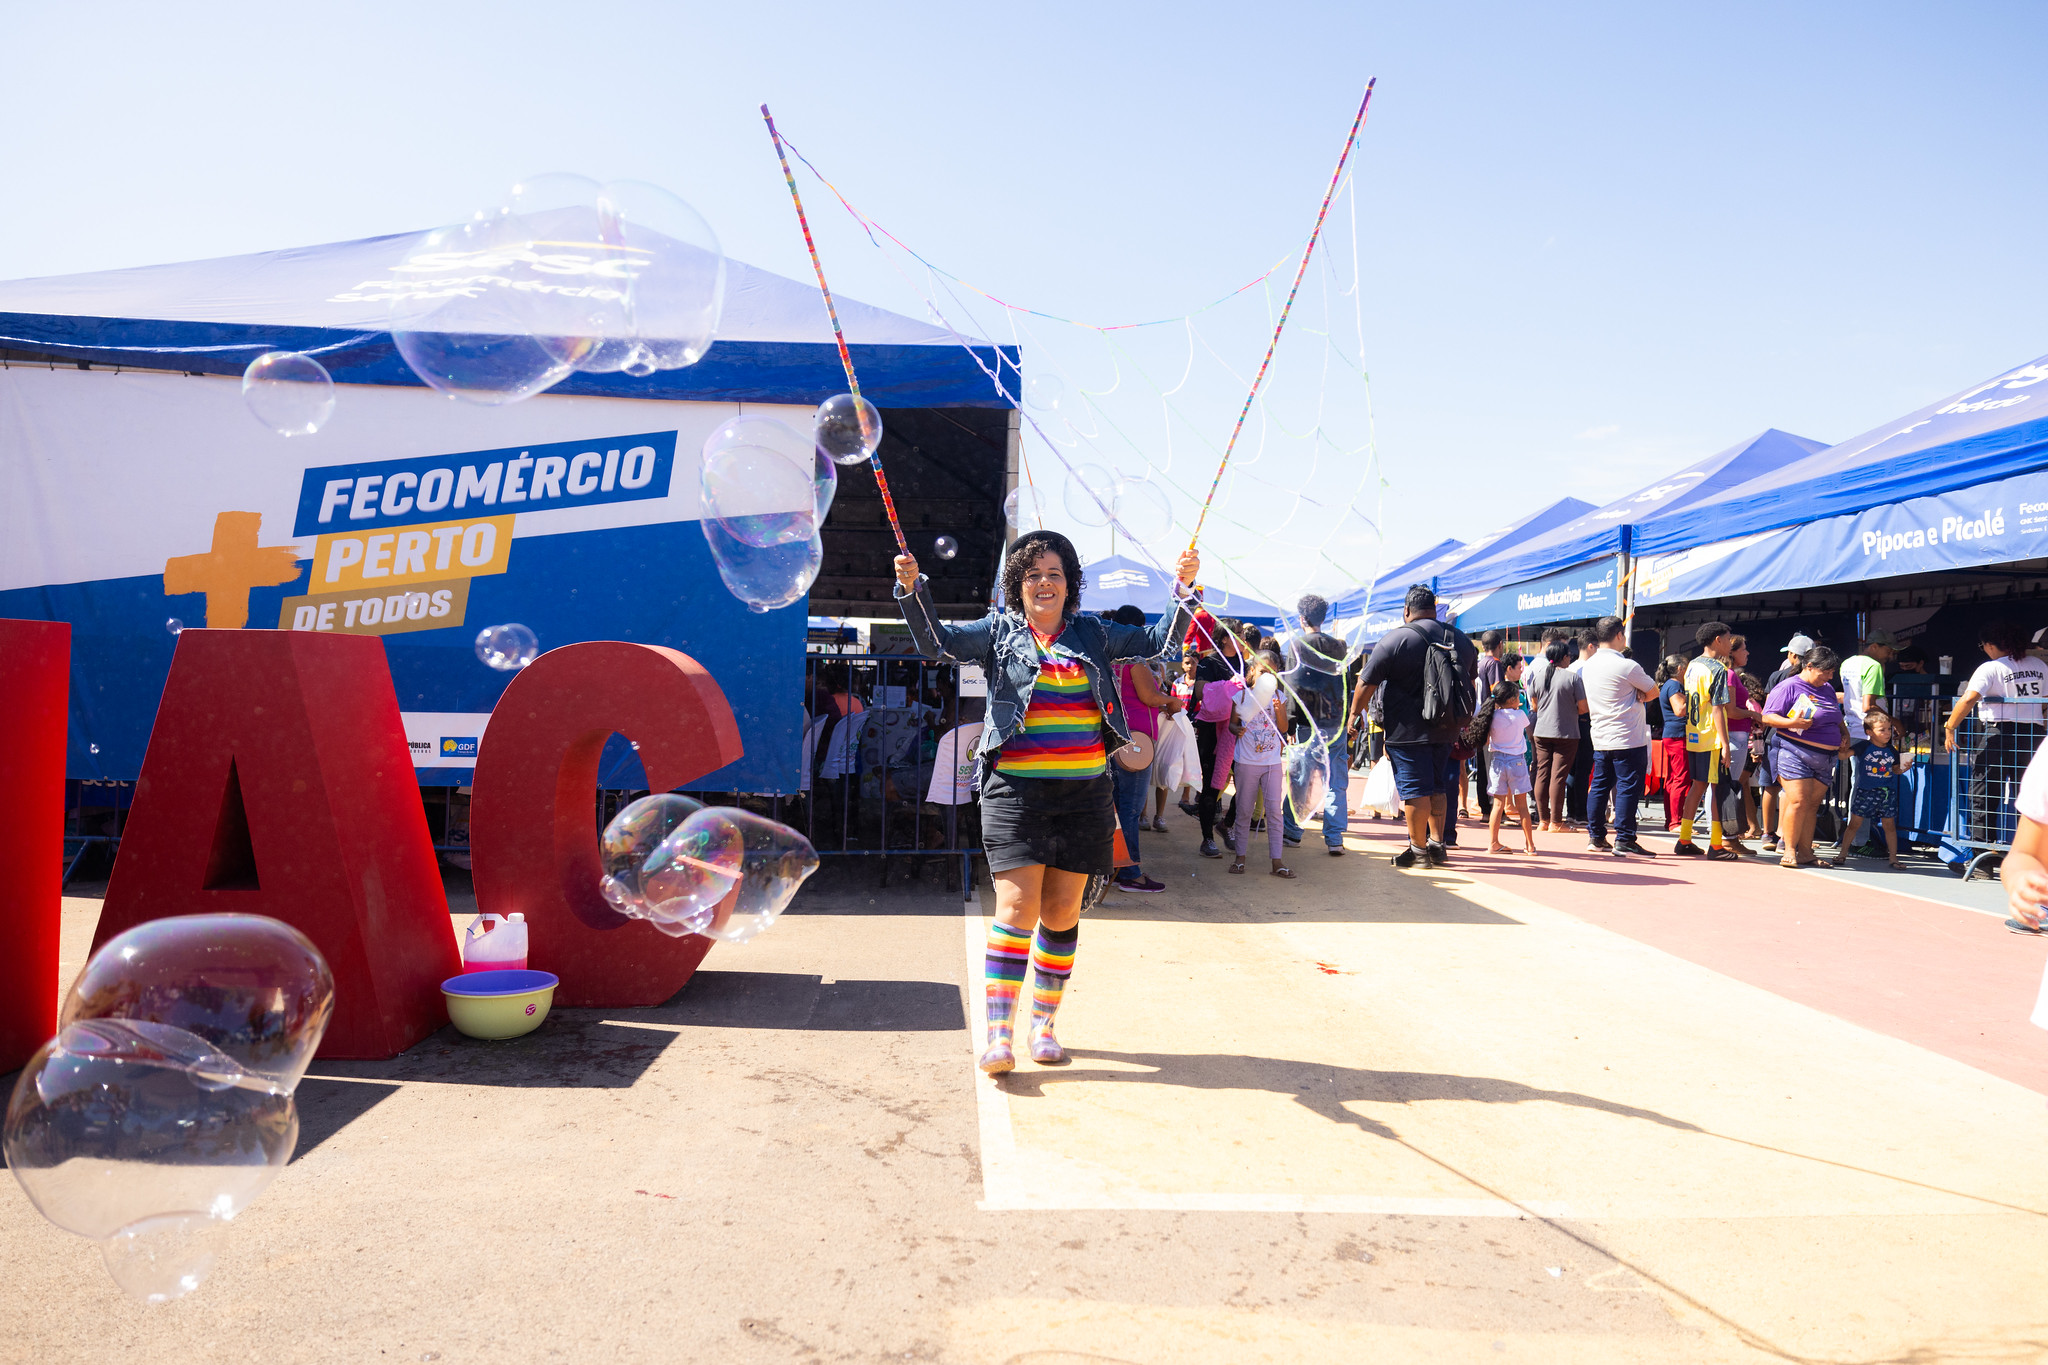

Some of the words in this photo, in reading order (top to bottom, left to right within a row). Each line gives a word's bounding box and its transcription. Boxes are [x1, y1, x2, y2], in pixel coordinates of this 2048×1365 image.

[318, 446, 656, 524] FECOMÉRCIO
[325, 521, 497, 583] PERTO
[1862, 527, 1925, 560] Pipoca
[1926, 527, 1938, 545] e
[1942, 507, 2005, 543] Picolé
[292, 601, 335, 632] DE
[342, 588, 454, 630] TODOS
[1517, 592, 1544, 611] Oficinas
[1544, 585, 1582, 607] educativas
[458, 743, 475, 751] GDF
[958, 765, 973, 775] SES
